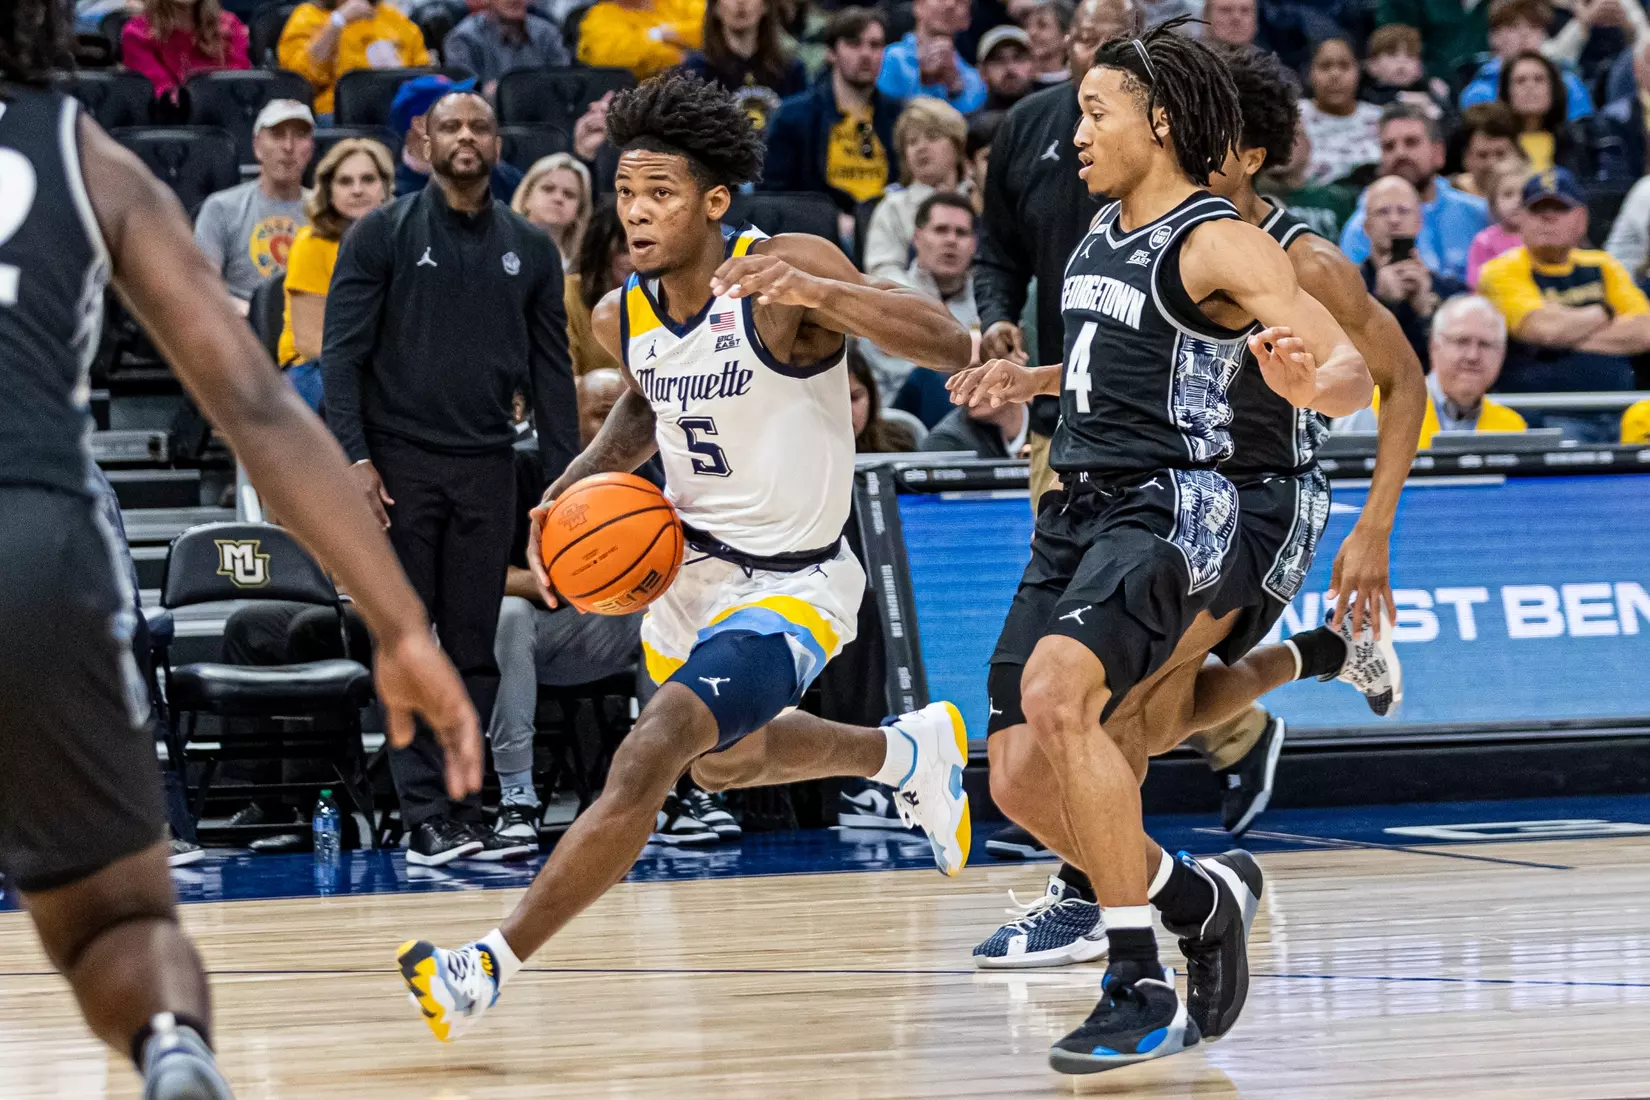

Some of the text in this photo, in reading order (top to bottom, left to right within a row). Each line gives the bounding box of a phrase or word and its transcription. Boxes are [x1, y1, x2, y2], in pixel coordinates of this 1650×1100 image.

[1129, 255, 1152, 265] EAST
[715, 338, 741, 350] EAST
[717, 333, 734, 343] BIG
[636, 360, 754, 412] Marquette
[1065, 321, 1098, 413] 4
[677, 416, 734, 478] 5
[214, 539, 270, 588] MU
[596, 569, 663, 612] ELITE
[1258, 586, 1490, 645] WST
